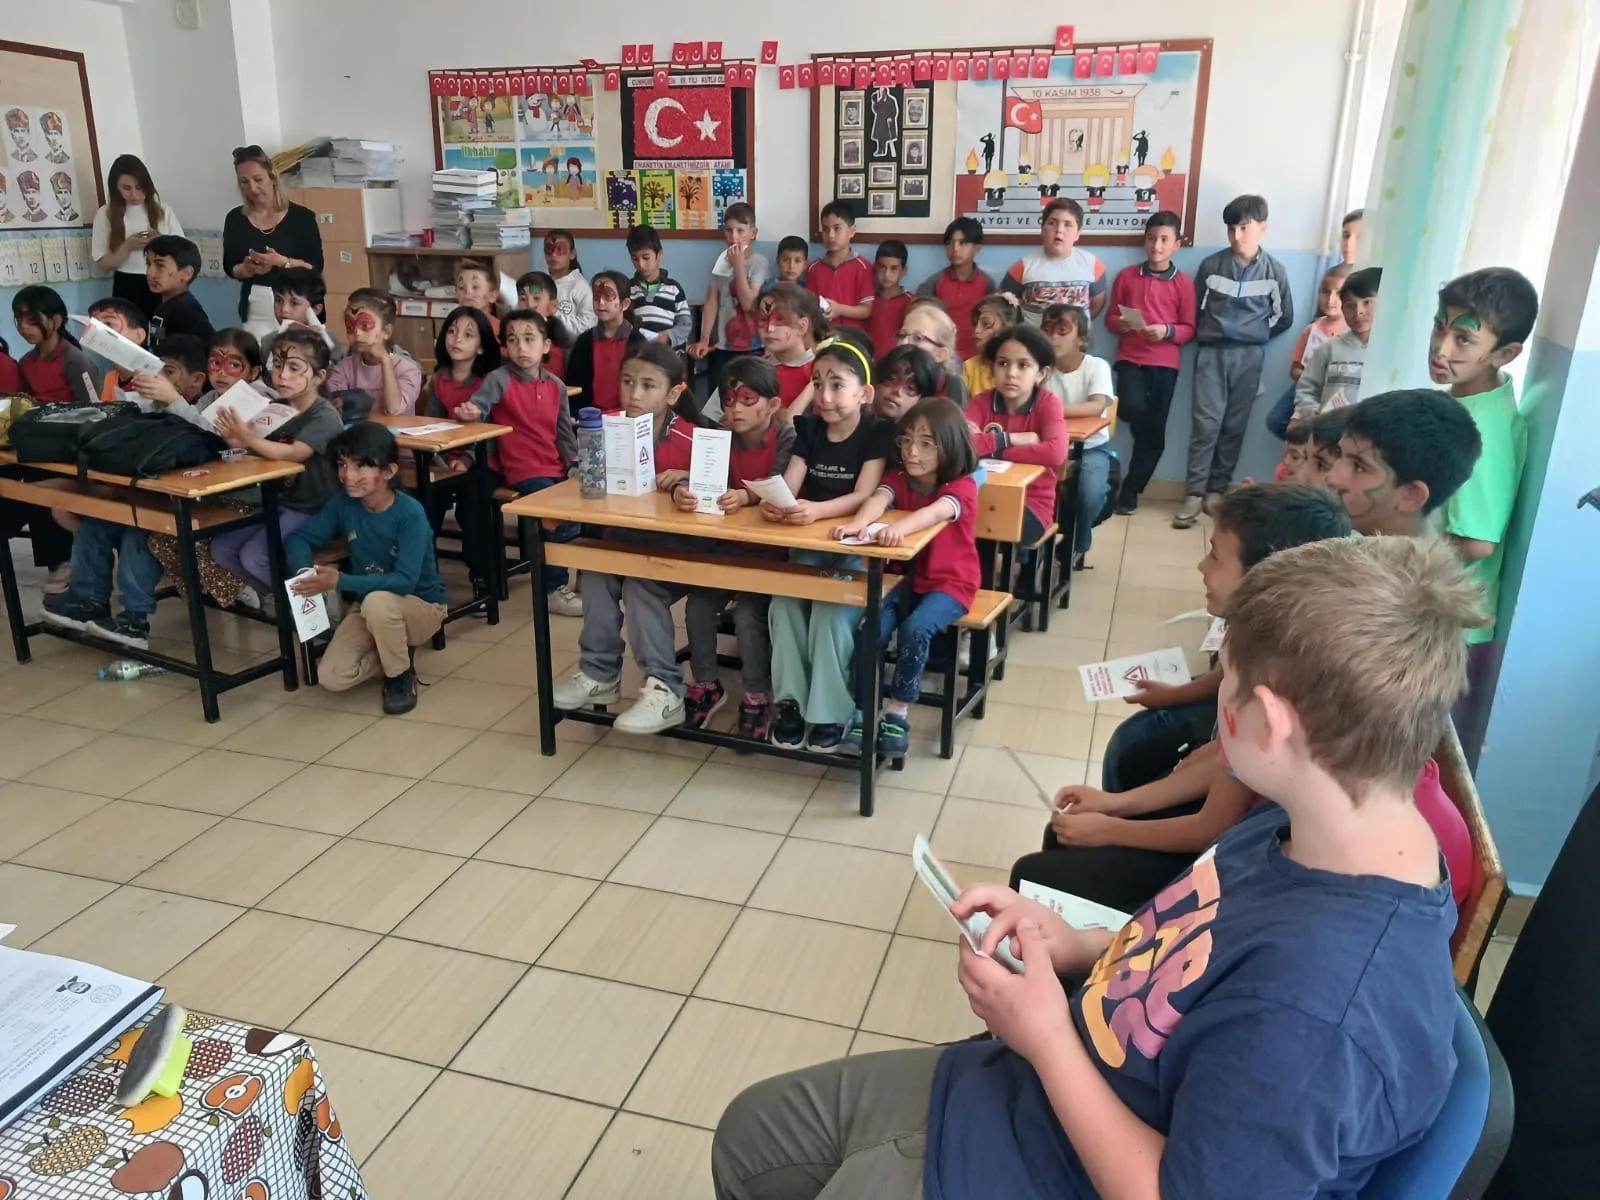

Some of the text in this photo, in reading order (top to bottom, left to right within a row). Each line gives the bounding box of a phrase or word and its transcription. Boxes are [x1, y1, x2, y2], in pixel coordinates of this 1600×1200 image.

[1032, 88, 1101, 98] 10 KASIM 1938
[978, 217, 1010, 225] AYGI
[1017, 217, 1031, 225] VE
[1098, 217, 1148, 226] ANIYOR
[30, 263, 39, 274] 12
[53, 262, 61, 274] 13
[208, 259, 220, 270] 20
